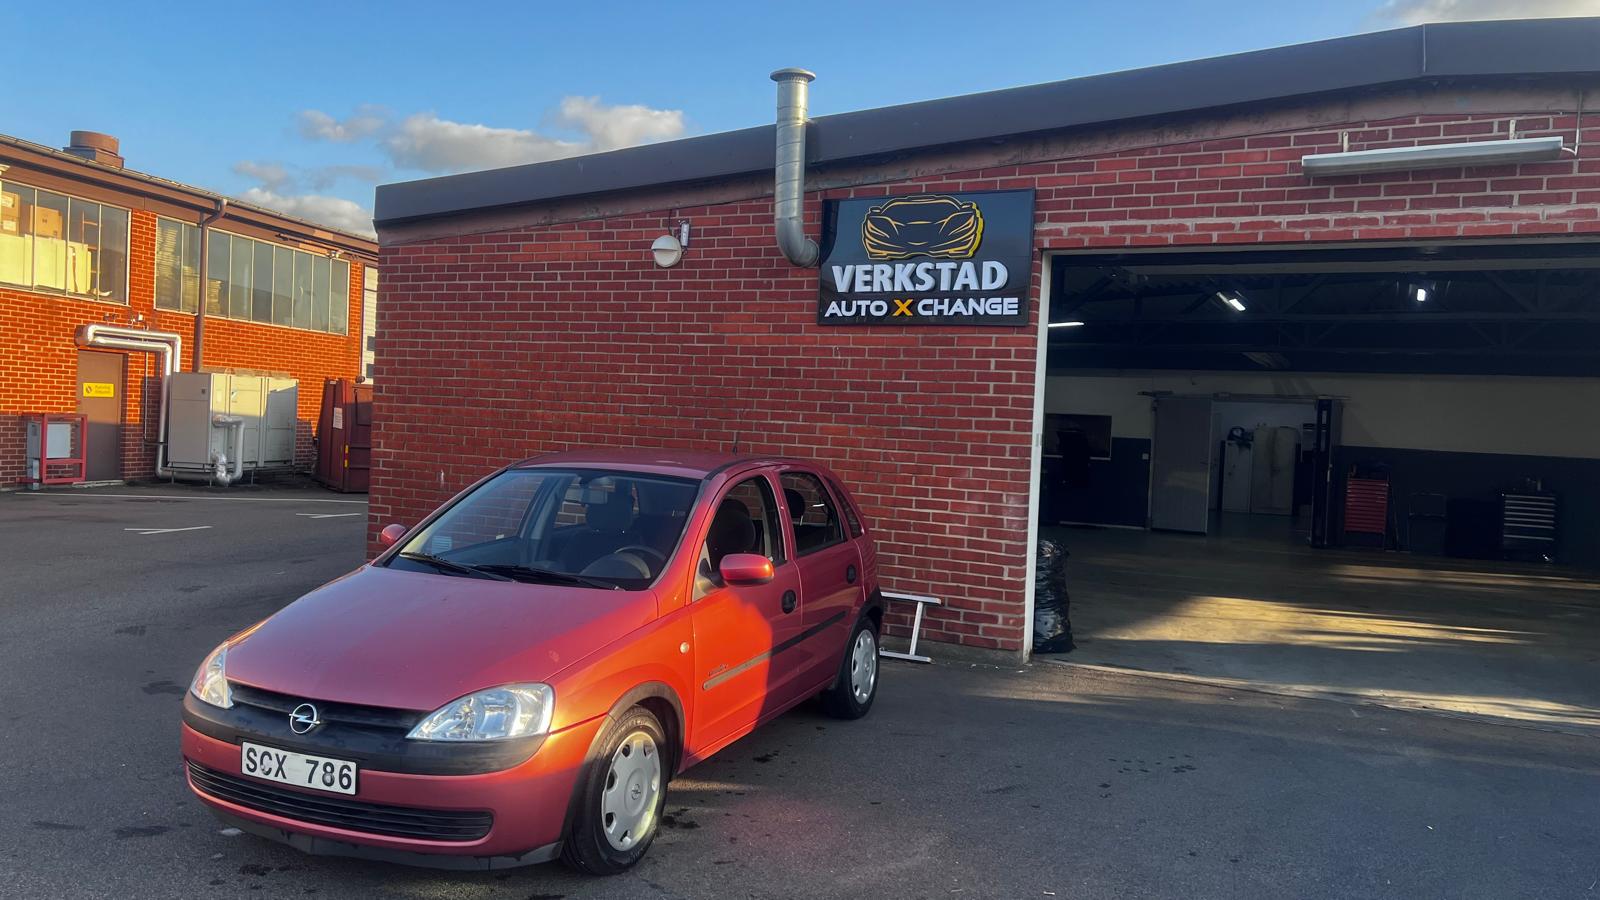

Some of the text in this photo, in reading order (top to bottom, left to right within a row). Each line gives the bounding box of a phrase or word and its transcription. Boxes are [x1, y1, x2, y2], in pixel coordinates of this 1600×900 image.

[832, 260, 1008, 293] VERKSTAD
[824, 297, 1018, 317] AUTO X CHANGE
[246, 747, 352, 790] SCX 786
